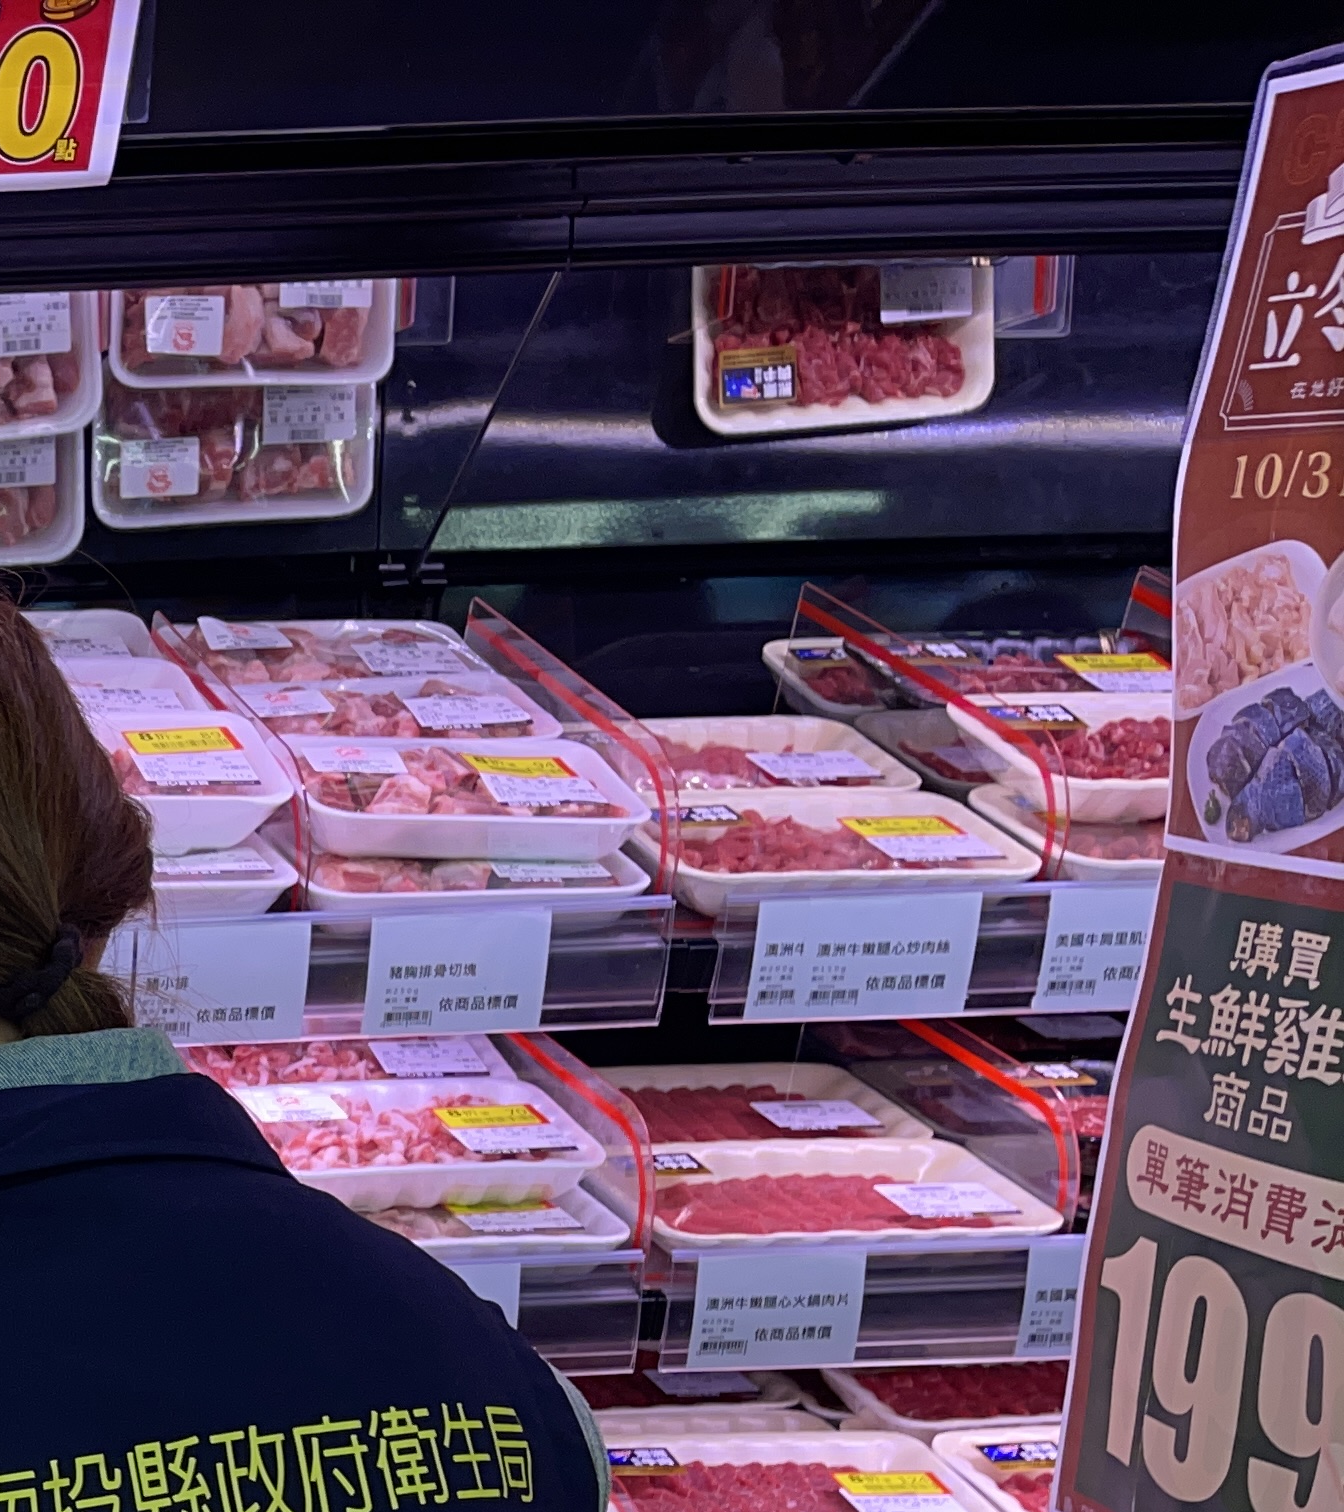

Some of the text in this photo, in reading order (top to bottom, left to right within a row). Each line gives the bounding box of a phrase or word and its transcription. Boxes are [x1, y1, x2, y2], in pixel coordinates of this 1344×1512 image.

[52, 138, 75, 161] 點
[1230, 451, 1344, 498] 10/3
[1231, 920, 1330, 989] 購買
[389, 963, 477, 980] 豬胸排骨切塊
[866, 974, 946, 991] 依商品標價
[196, 1005, 276, 1022] 依商品標價
[439, 994, 518, 1013] 依商品標價
[1156, 974, 1344, 1086] 生鮮雞
[1204, 1072, 1291, 1142] 商品
[754, 1325, 832, 1342] 依商品標價
